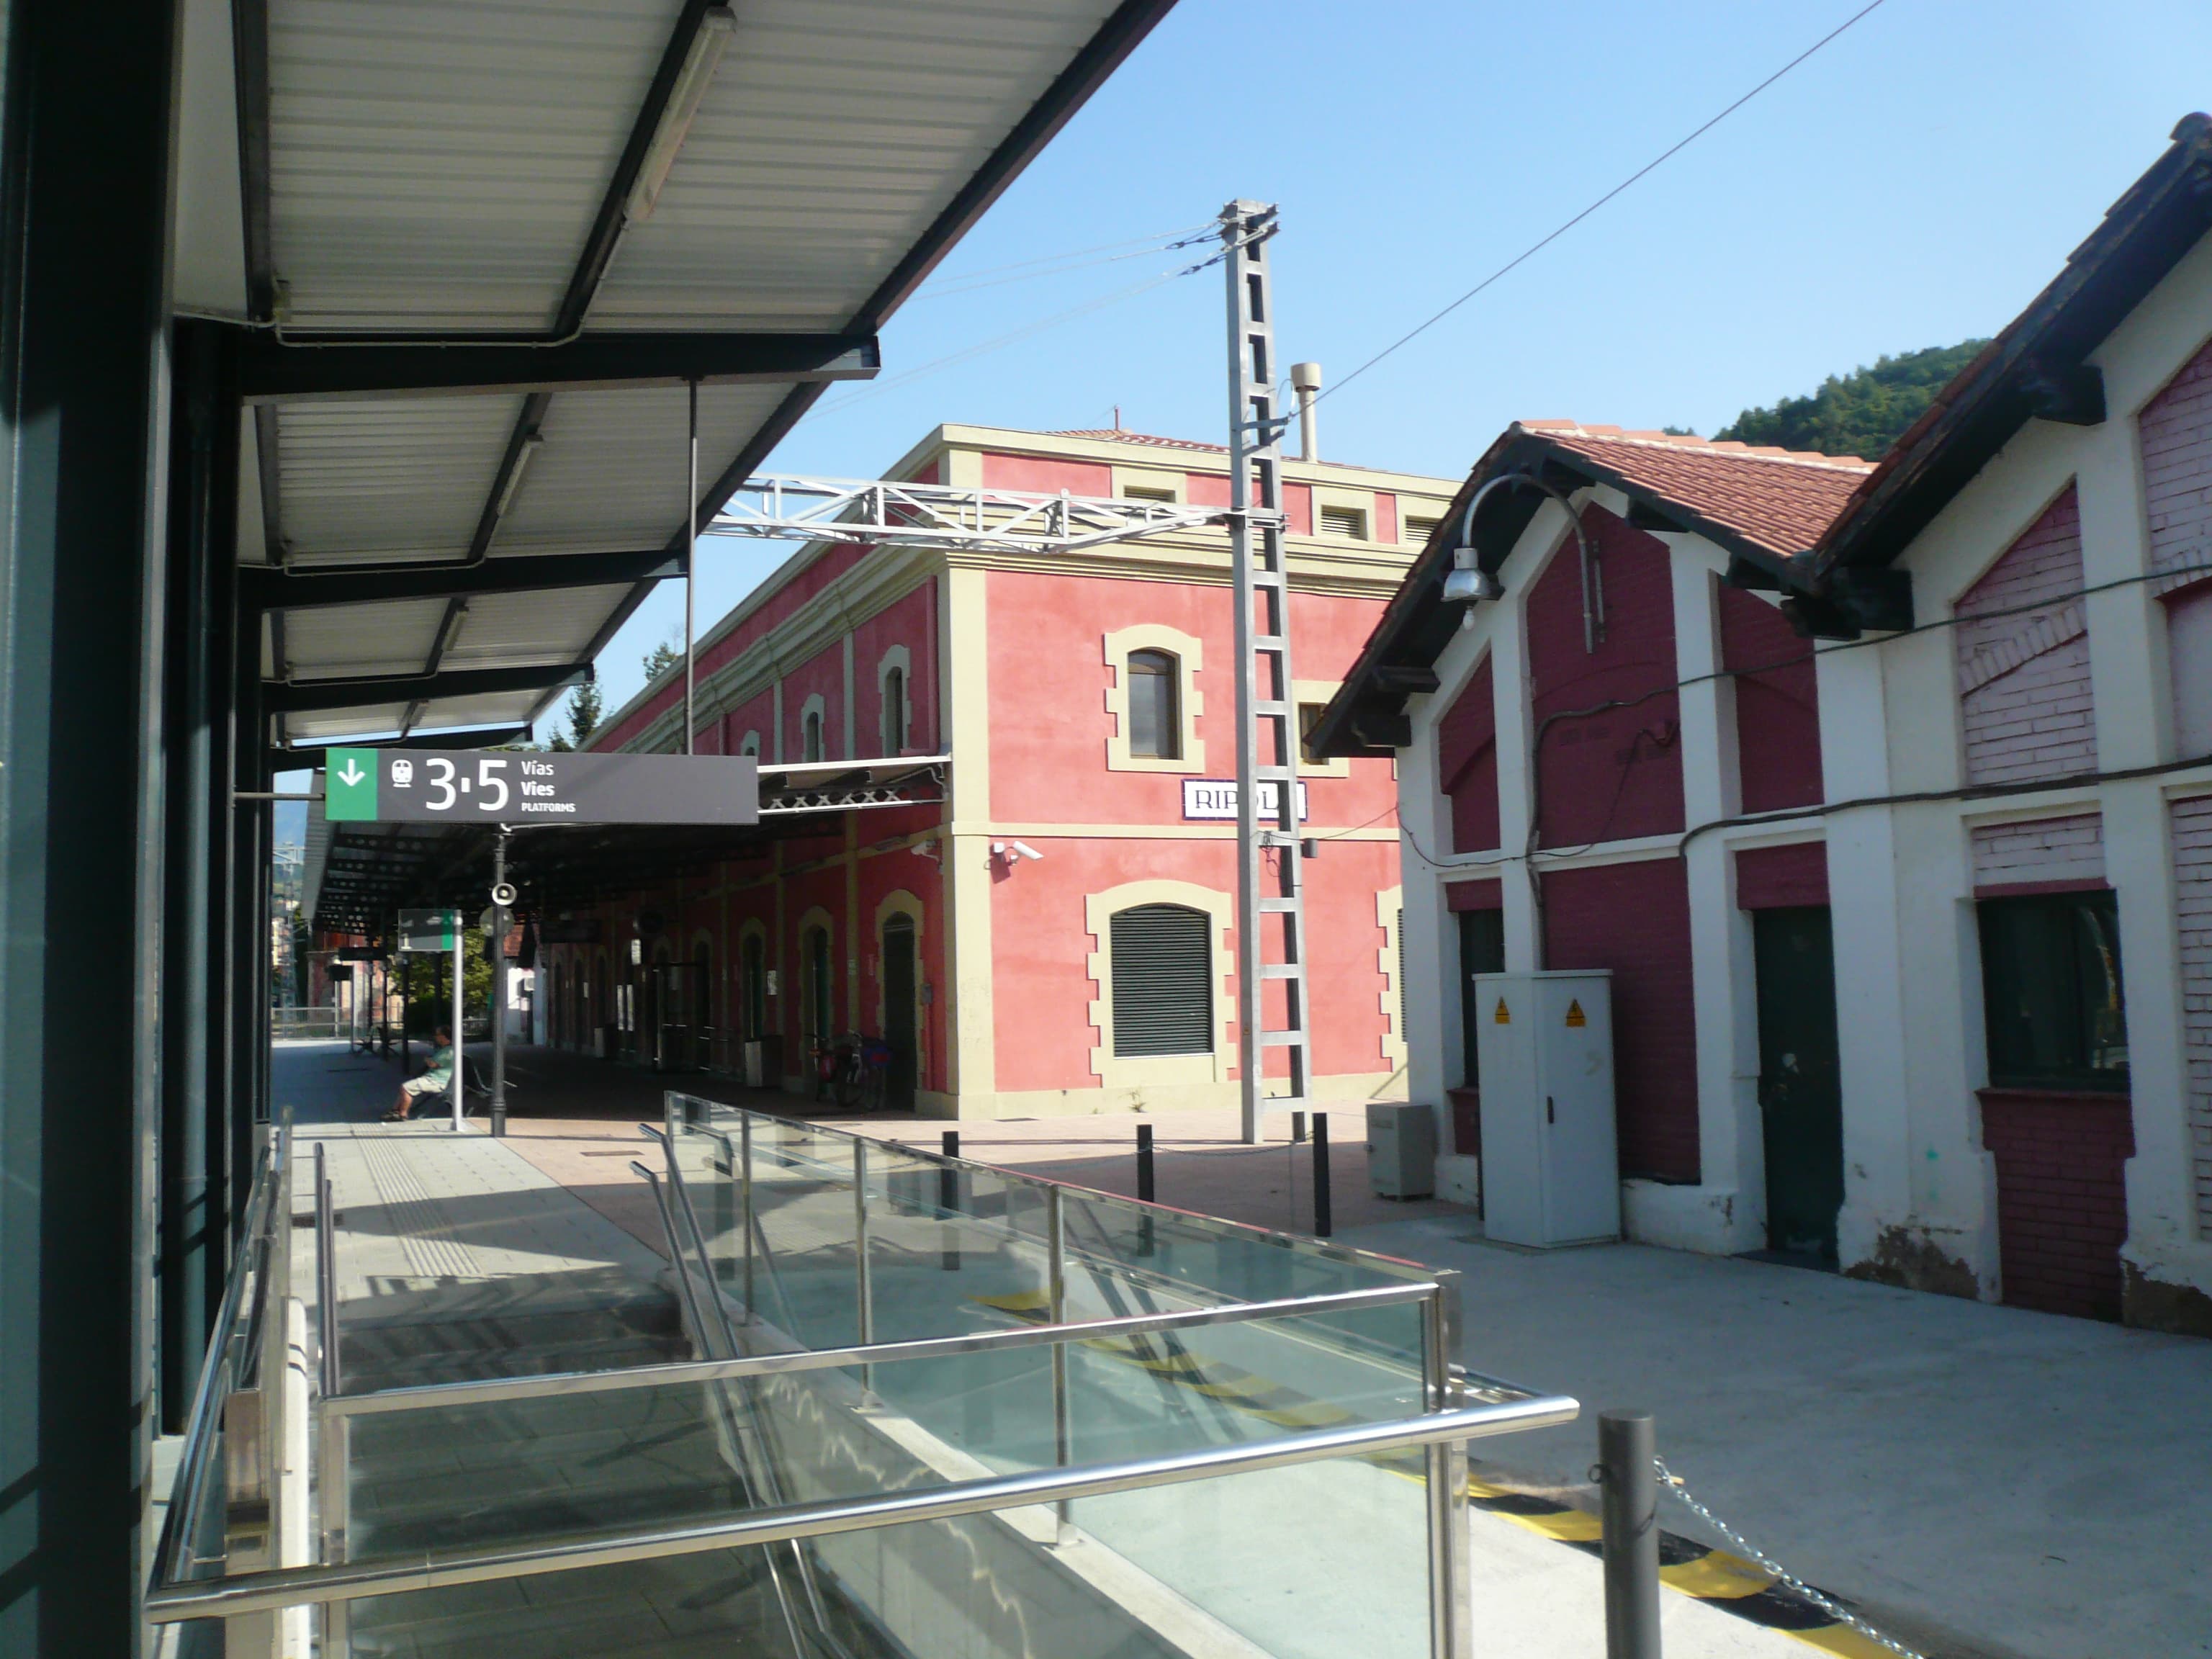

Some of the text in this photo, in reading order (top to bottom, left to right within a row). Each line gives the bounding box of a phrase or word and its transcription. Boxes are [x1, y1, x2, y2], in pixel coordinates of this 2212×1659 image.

[521, 760, 554, 775] Vías
[521, 781, 555, 796] Vies
[521, 802, 577, 812] PLATFORMS
